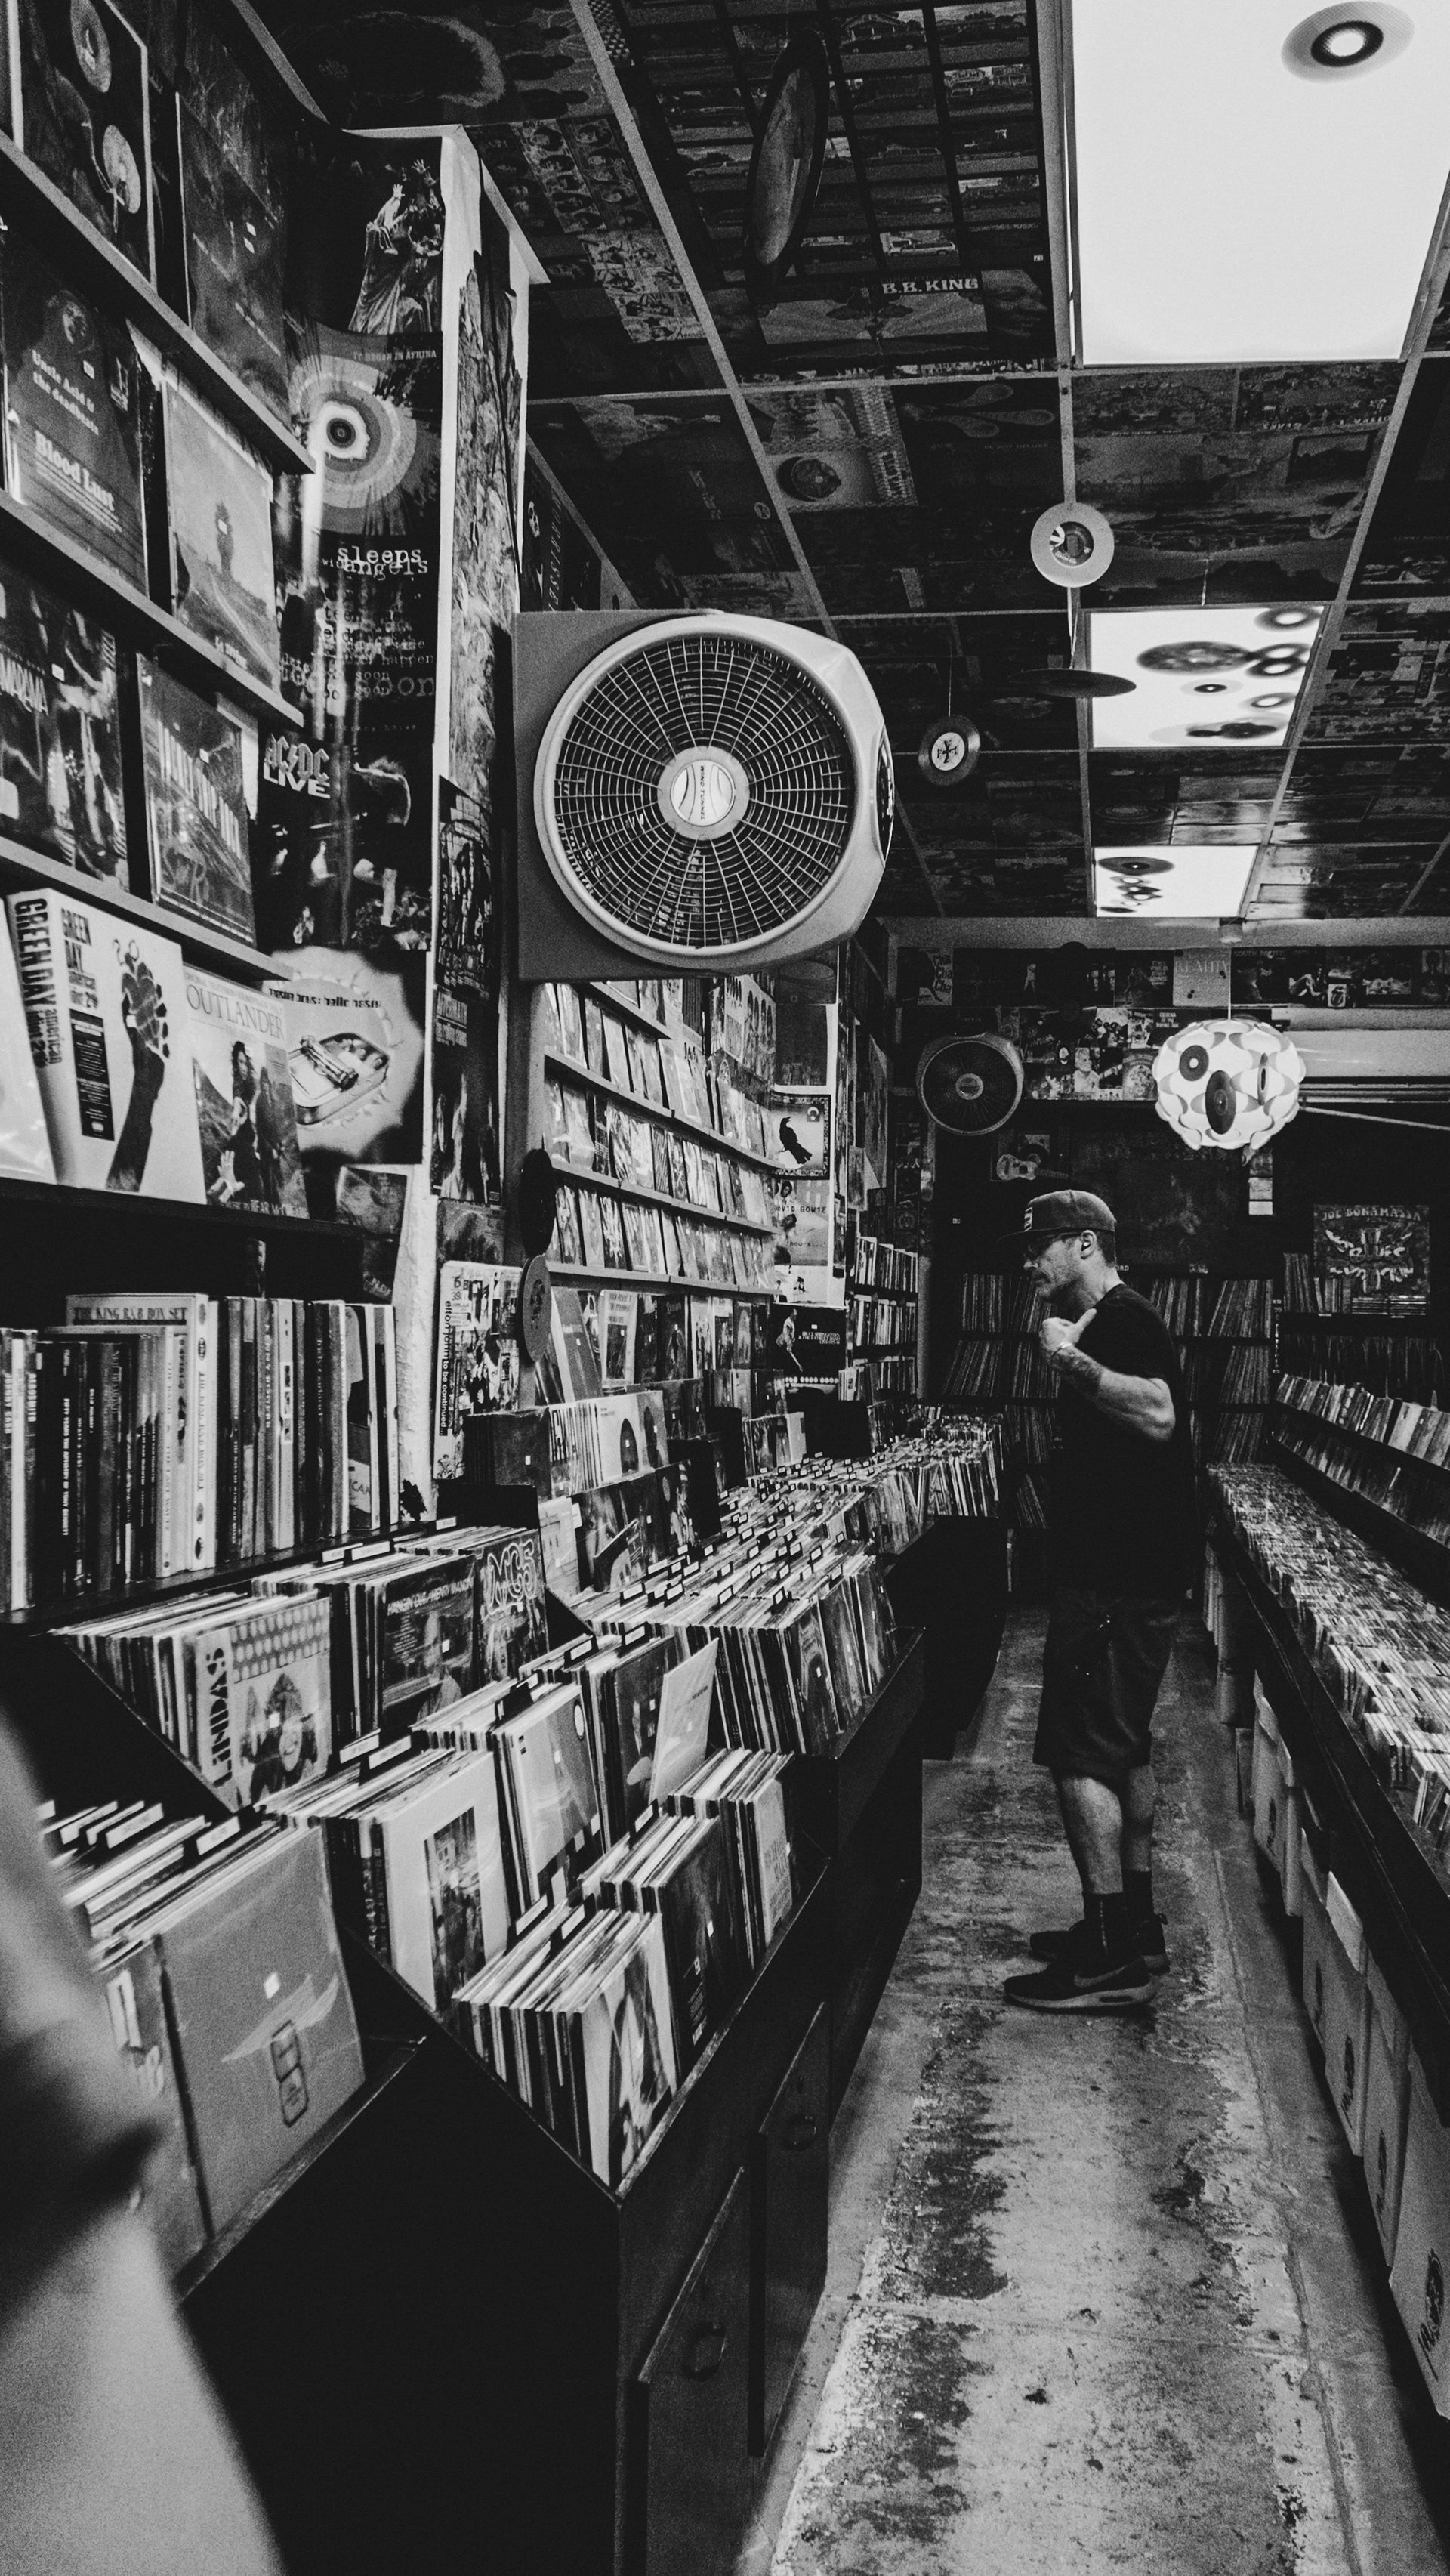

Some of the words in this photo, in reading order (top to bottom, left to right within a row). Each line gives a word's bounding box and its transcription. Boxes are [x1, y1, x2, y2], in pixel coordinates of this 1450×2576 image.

[882, 282, 922, 294] B.B.
[925, 278, 979, 291] KING
[35, 430, 81, 484] Blood
[82, 467, 115, 511] Lust
[338, 545, 421, 568] sleeps
[344, 558, 428, 581] angels
[264, 733, 330, 783] AC/DC
[263, 761, 331, 799] LIVE
[15, 897, 52, 968] GREEN
[933, 954, 952, 967] Cha
[936, 965, 953, 979] Cha
[22, 967, 57, 1008] DAY
[935, 980, 952, 994] Cha
[187, 984, 285, 1040] OUTLANDER
[1322, 1209, 1342, 1222] JOE
[168, 1307, 188, 1320] SET
[444, 1300, 453, 1330] elton
[442, 1332, 452, 1359] john
[441, 1371, 449, 1382] be
[442, 1360, 449, 1369] to
[28, 1373, 37, 1422] AEROSMITH
[440, 1385, 448, 1435] continued...
